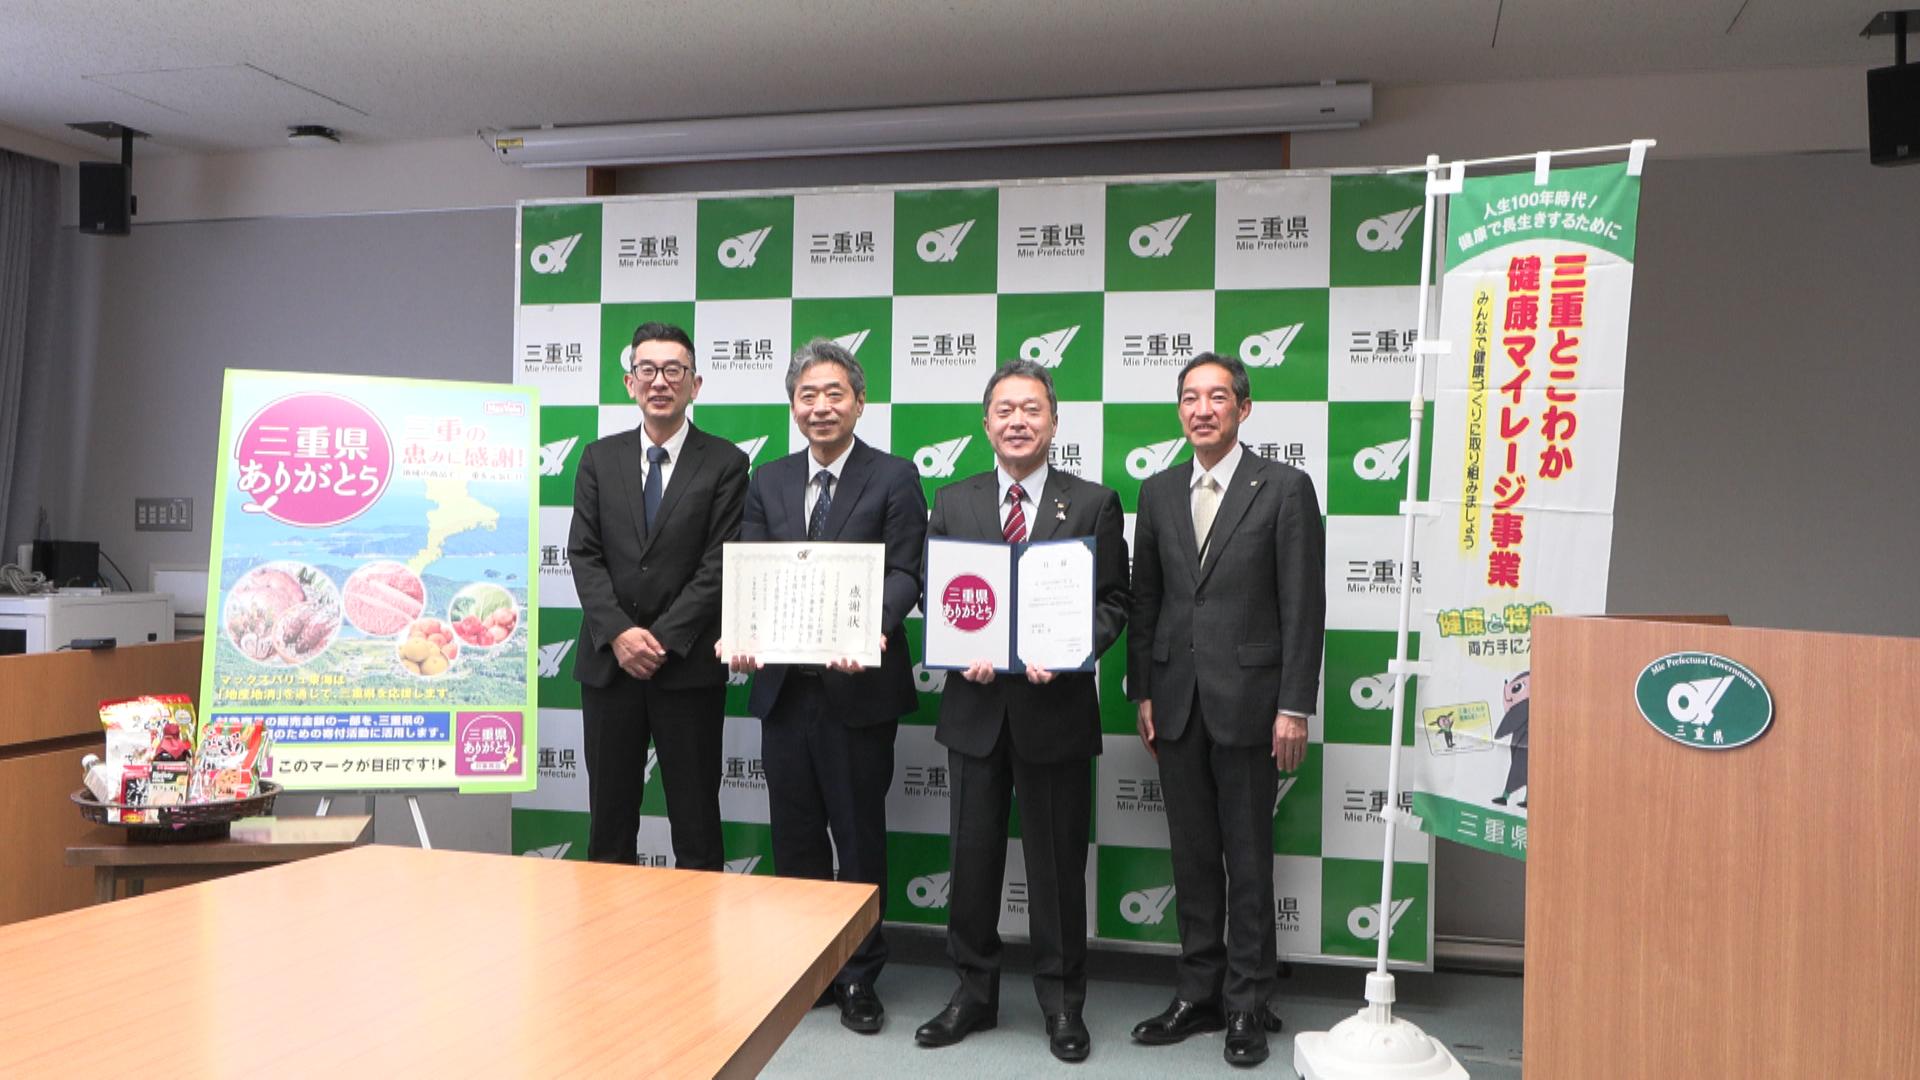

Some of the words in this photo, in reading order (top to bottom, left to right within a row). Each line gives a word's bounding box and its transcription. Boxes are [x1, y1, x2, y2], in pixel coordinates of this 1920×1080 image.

[1017, 224, 1085, 248] 三重県
[1236, 216, 1309, 240] 三重県
[1458, 210, 1622, 251] 健康で長生きするために
[619, 236, 679, 257] 三重県
[810, 231, 875, 254] 三重県
[1236, 241, 1254, 250] Mie
[1257, 240, 1309, 250] Prefecture
[810, 255, 826, 263] Mie
[829, 254, 875, 264] Prefecture
[1017, 249, 1034, 258] Mie
[1037, 248, 1085, 257] Prefecture
[524, 343, 582, 364] 三重県
[712, 339, 773, 360] 三重県
[910, 334, 976, 356] 三重県
[1122, 333, 1193, 356] 三重県
[730, 361, 773, 370] Prefecture
[911, 357, 927, 366] Mie
[931, 356, 976, 365] Prefecture
[1123, 357, 1140, 366] Mie
[1144, 357, 1189, 366] Prefectur
[1351, 355, 1369, 363] Mie
[1372, 354, 1415, 363] Prefectu
[1539, 254, 1587, 479] 三重とこわか
[542, 365, 583, 373] Prefecture
[1463, 291, 1489, 550] みんなで健康づくりに取り組みましょう
[1488, 255, 1541, 588] 健康マイレージ事業
[254, 425, 370, 460] 三重県
[1246, 443, 1305, 467] 重県
[238, 460, 381, 497] ありがとう
[948, 587, 989, 604] 三重県
[1347, 584, 1366, 592] Mie
[848, 585, 862, 629] 感謝状
[942, 603, 993, 621] ありがとう
[1651, 663, 1666, 676] Mie
[1666, 656, 1708, 668] Prefectural
[1709, 658, 1756, 689] Government
[468, 727, 507, 740] 三重県
[1675, 725, 1724, 744] 三重県
[464, 741, 510, 754] ありがとう
[278, 757, 436, 773] このマークが目印です!
[538, 748, 576, 769] 重県
[726, 757, 765, 779] 重県
[905, 787, 920, 796] Mie
[1117, 801, 1134, 810] Mie
[1345, 812, 1362, 821] Mie
[1008, 904, 1025, 913] Mie
